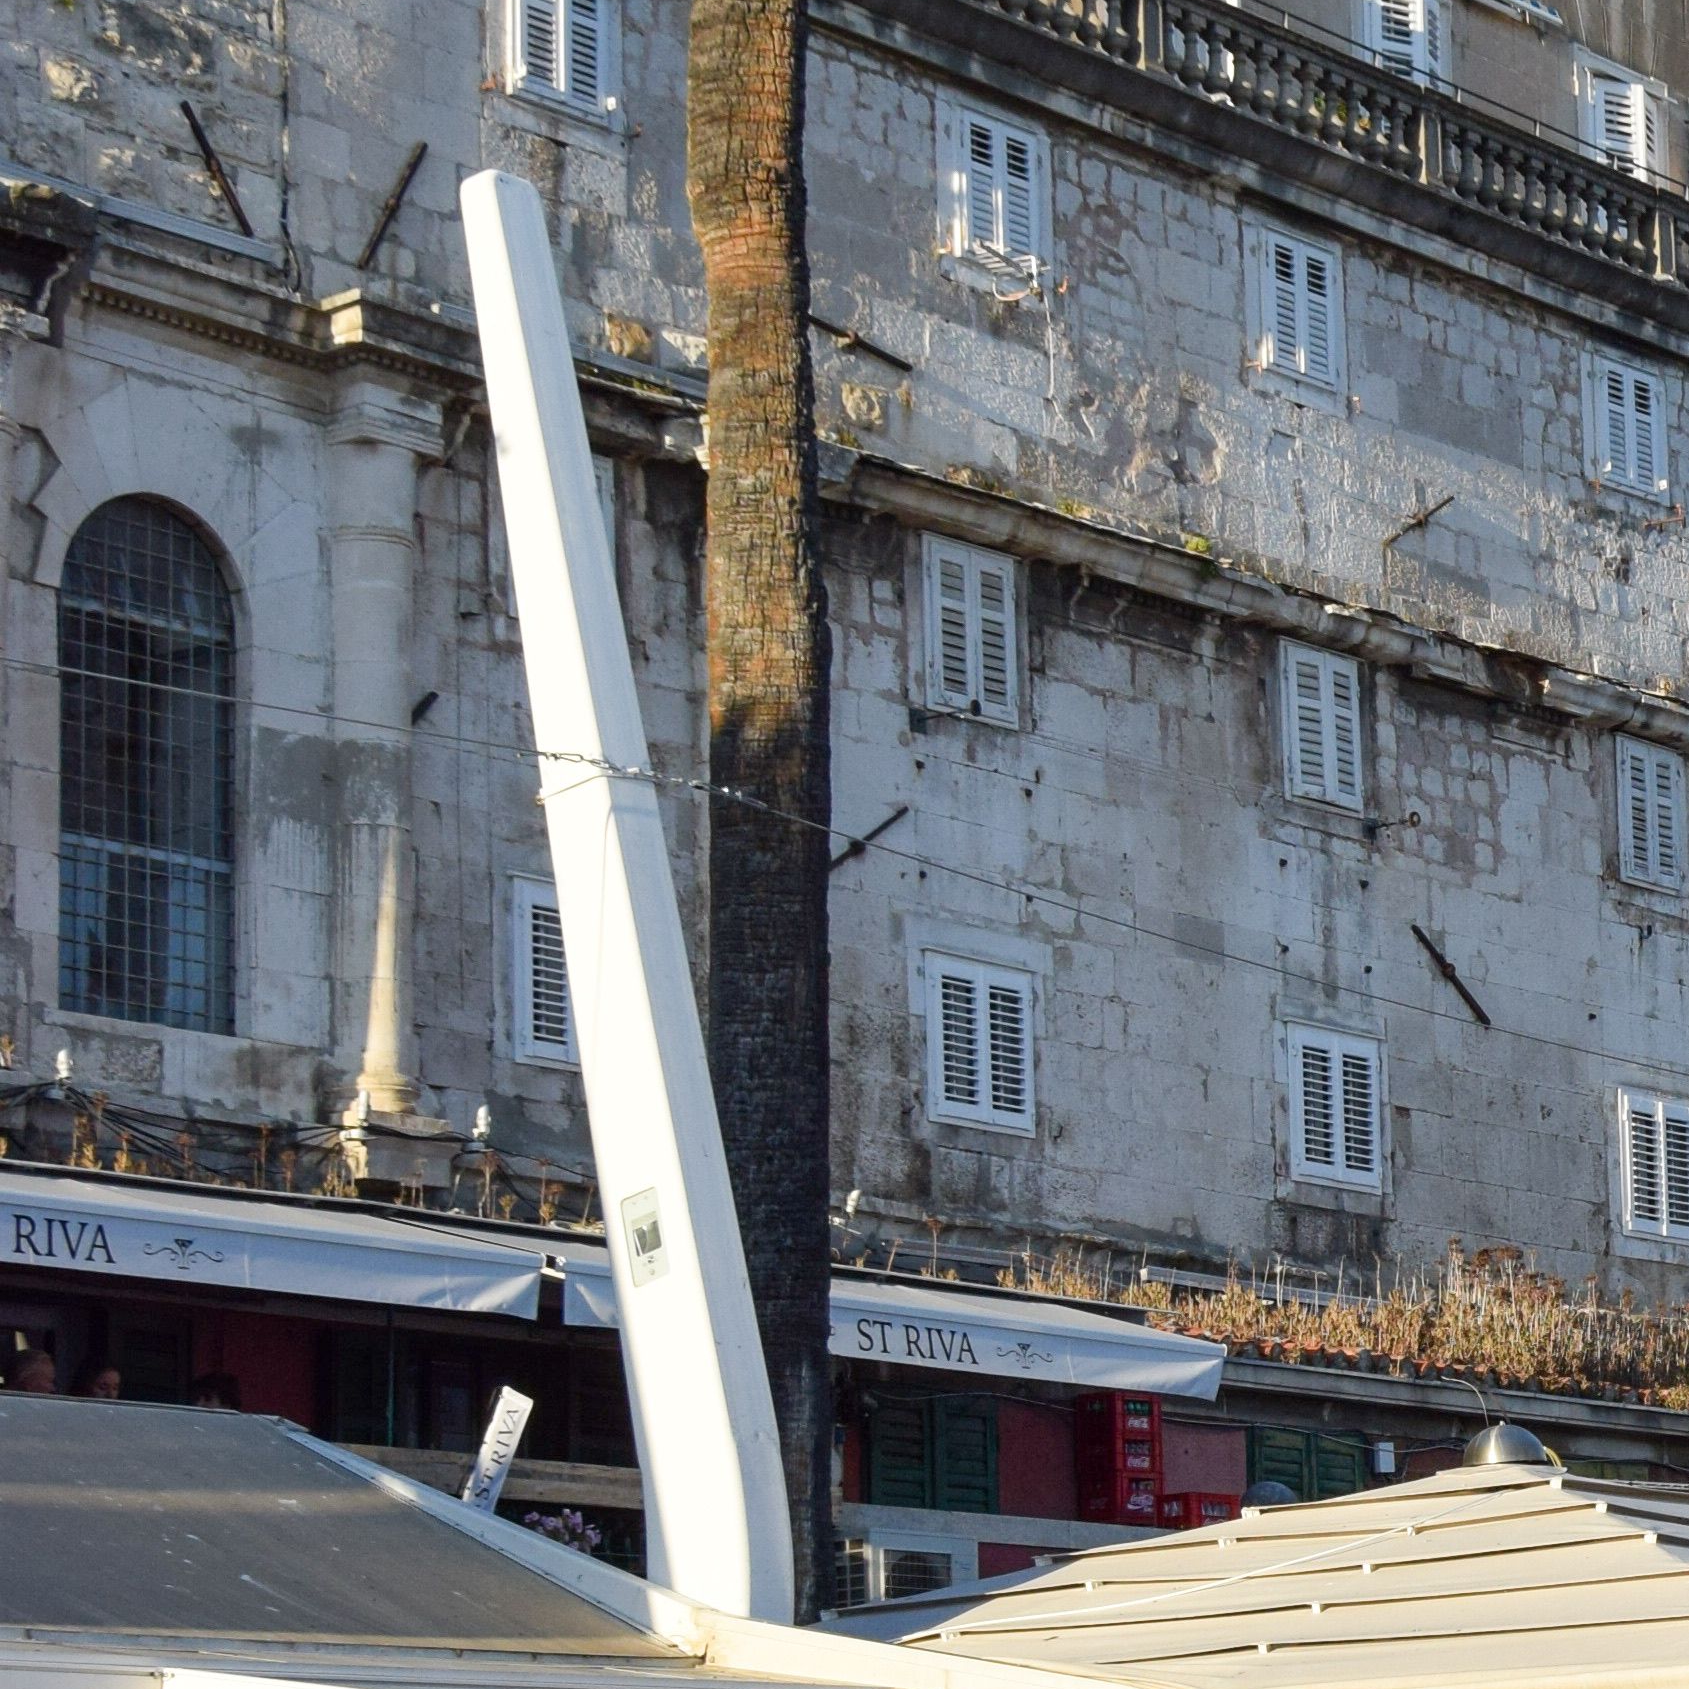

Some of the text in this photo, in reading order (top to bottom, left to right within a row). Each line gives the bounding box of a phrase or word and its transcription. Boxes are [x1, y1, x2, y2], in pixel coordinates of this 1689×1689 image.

[11, 1213, 117, 1265] RIVA
[857, 1317, 980, 1366] ST RIVA
[491, 1409, 520, 1466] RIVA
